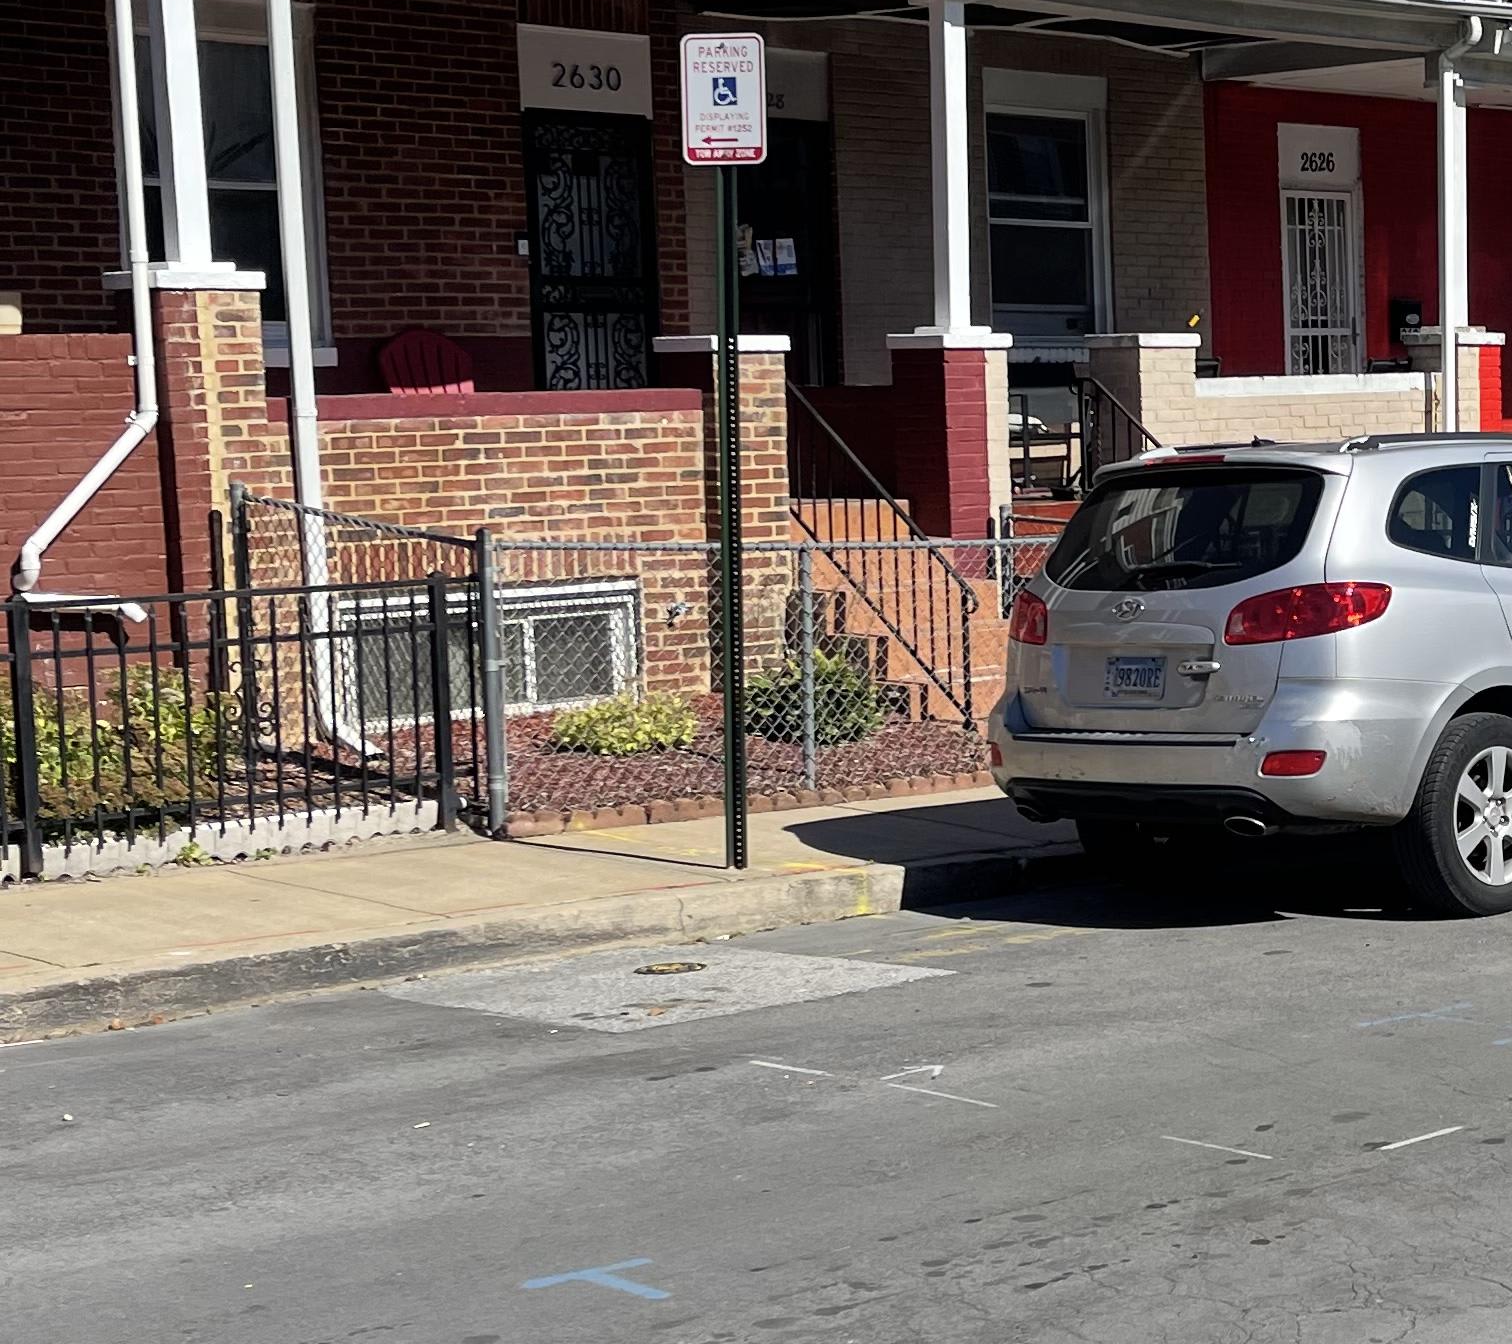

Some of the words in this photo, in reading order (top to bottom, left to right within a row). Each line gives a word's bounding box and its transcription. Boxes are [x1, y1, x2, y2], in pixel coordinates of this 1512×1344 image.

[698, 46, 748, 58] PARKING
[693, 61, 754, 73] RESERVED
[551, 62, 622, 92] 2630
[694, 123, 725, 134] PERMIT
[1300, 152, 1336, 173] 2626
